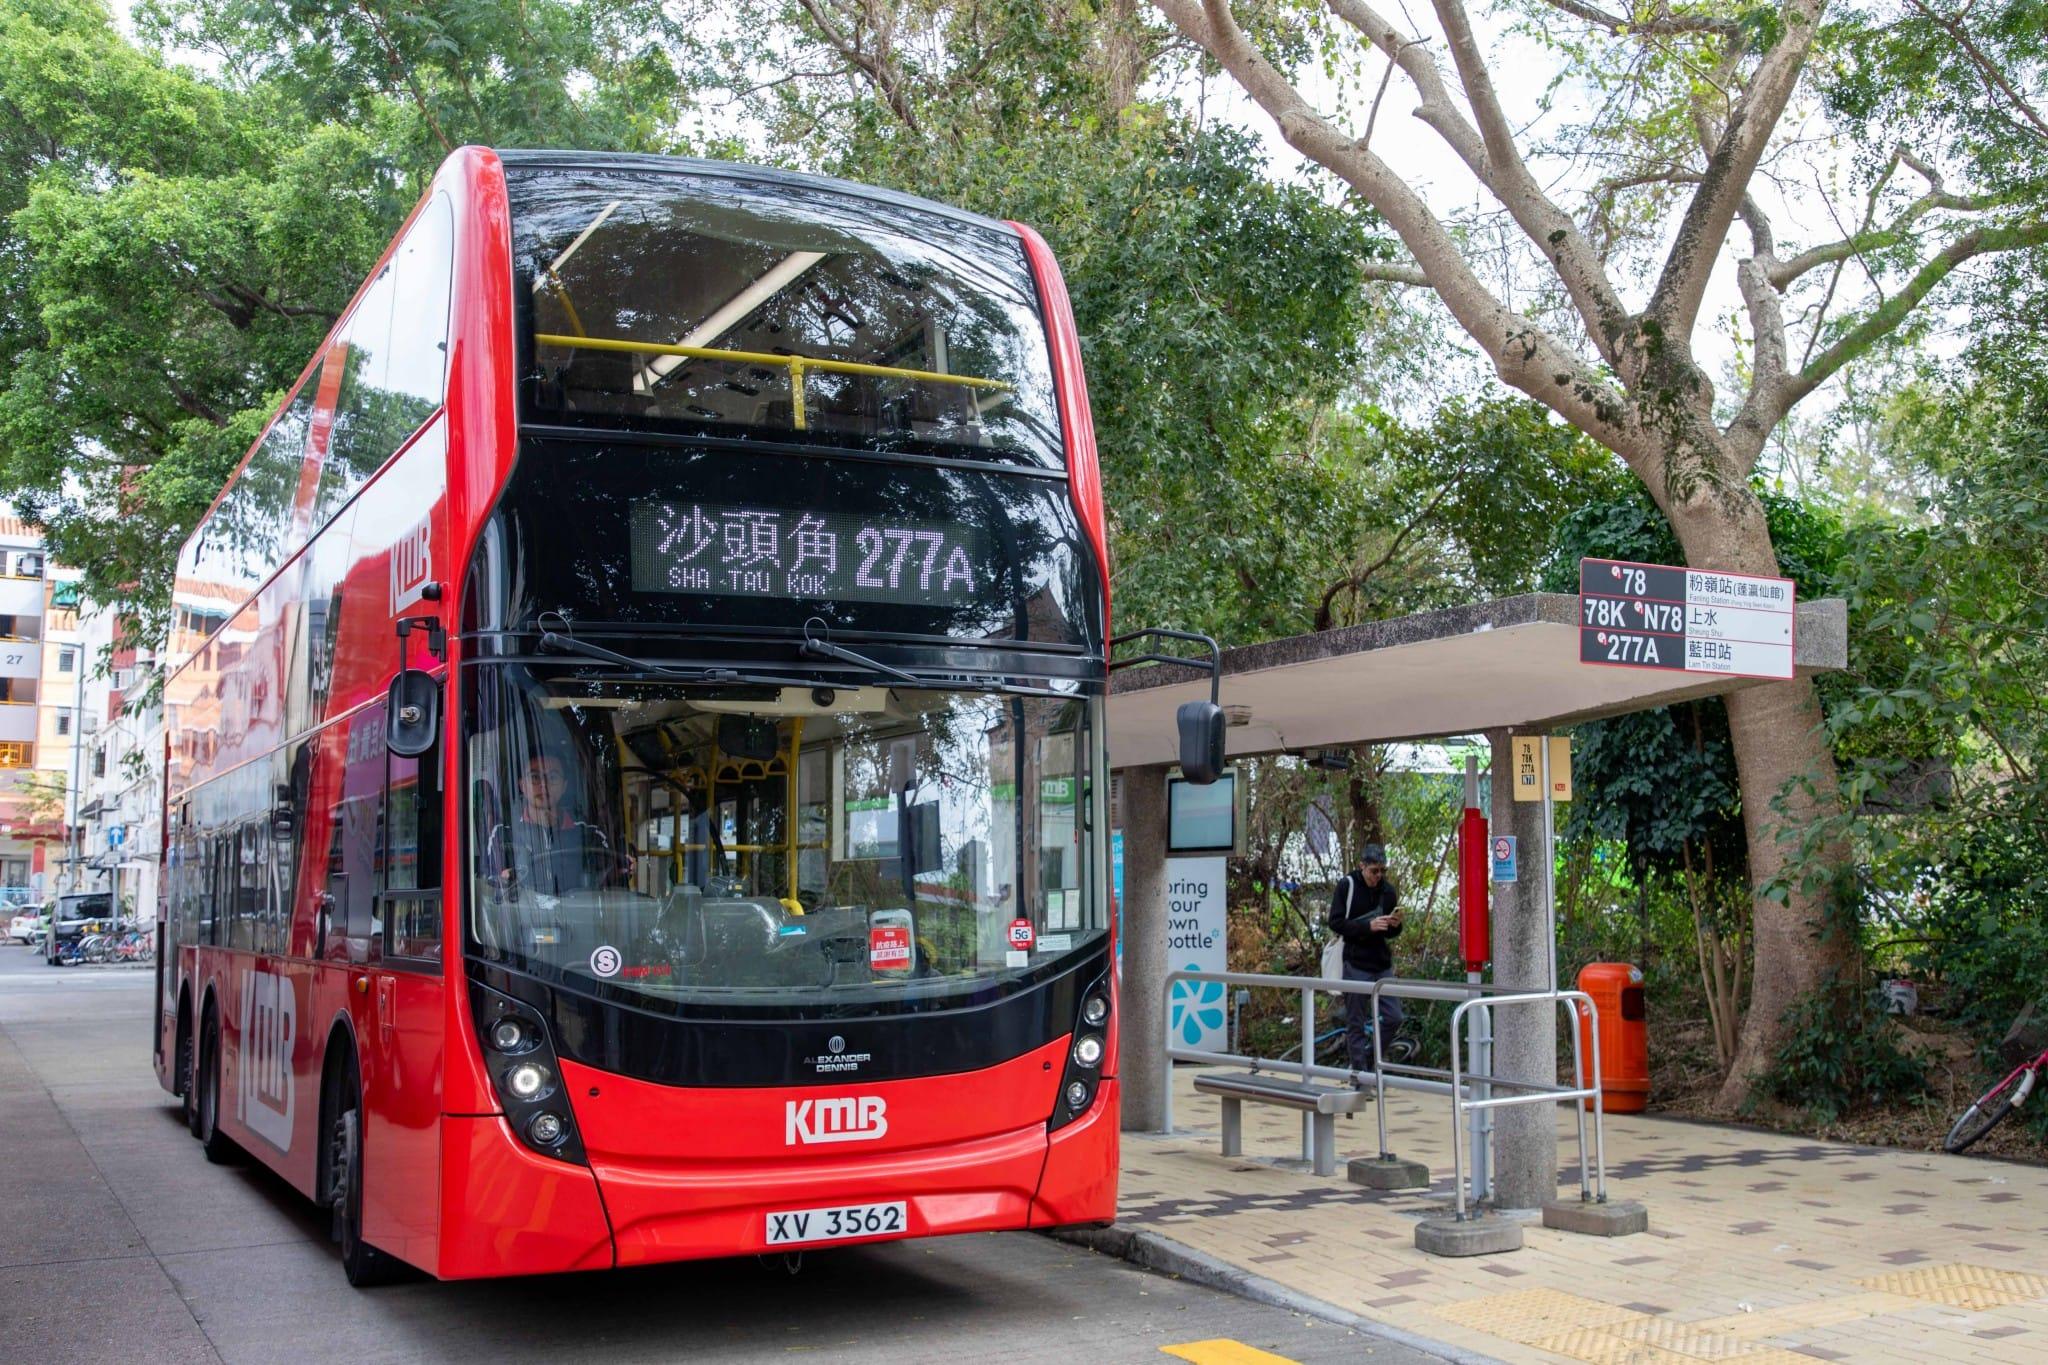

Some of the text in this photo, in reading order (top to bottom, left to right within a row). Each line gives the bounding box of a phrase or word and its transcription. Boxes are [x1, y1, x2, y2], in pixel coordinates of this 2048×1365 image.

[657, 504, 838, 575] 沙頭角
[389, 510, 432, 619] KMB
[854, 526, 976, 594] 277A
[668, 566, 827, 595] SHA TAU KOK
[1622, 568, 1647, 596] 78
[1689, 594, 1710, 605] Fanling
[1711, 595, 1731, 604] Station
[1585, 598, 1683, 632] 78K N78
[1689, 607, 1718, 626] 上水
[6, 654, 24, 665] 27
[1607, 634, 1660, 664] 277A
[1688, 640, 1732, 661] 藍田站
[1688, 660, 1731, 671] Lam Tin Station
[1521, 753, 1533, 763] 78K
[1523, 743, 1531, 753] 78
[1521, 763, 1535, 774] 277A
[1168, 899, 1202, 913] our
[237, 969, 297, 1153] KMB
[803, 1053, 871, 1065] ALEXANDER
[816, 1062, 859, 1073] DENNIS
[785, 1096, 888, 1145] KMB
[772, 1206, 900, 1241] XV 3562
